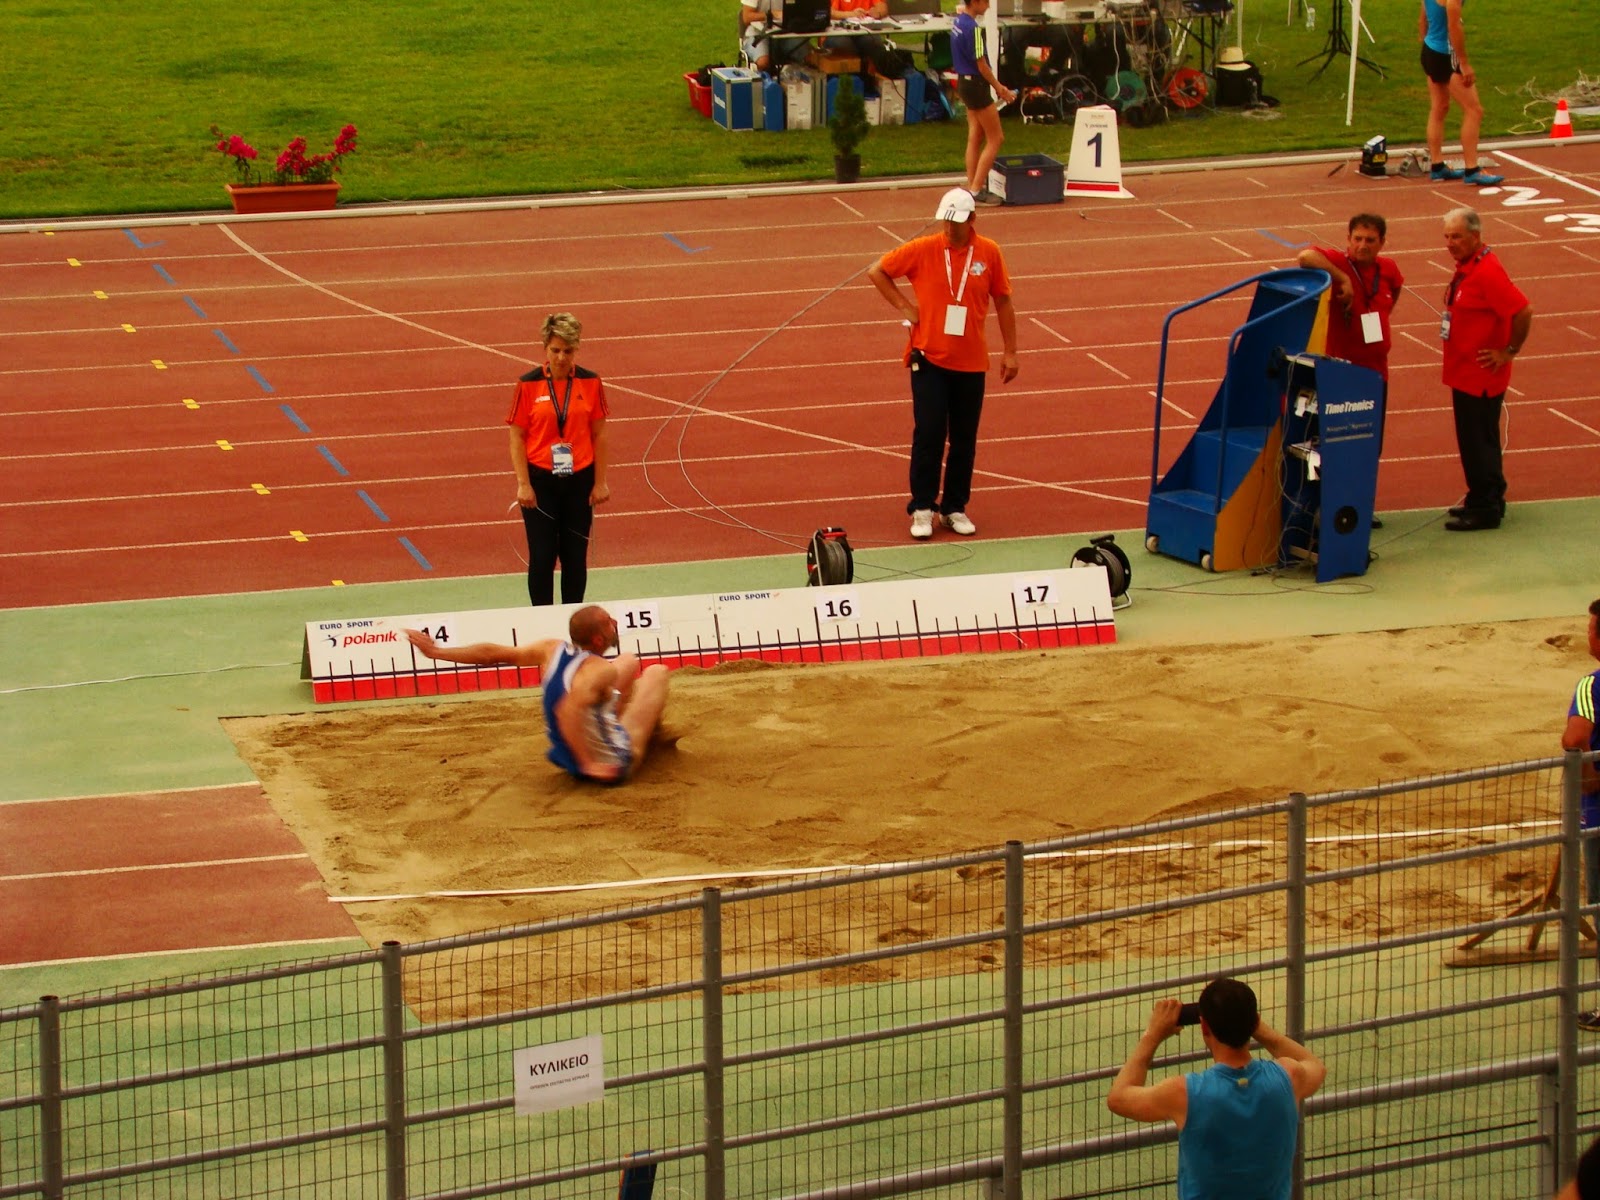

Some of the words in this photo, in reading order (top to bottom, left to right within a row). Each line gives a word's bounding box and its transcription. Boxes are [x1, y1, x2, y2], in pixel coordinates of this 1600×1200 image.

[1087, 132, 1102, 168] 1
[1478, 185, 1565, 207] 2
[1325, 399, 1375, 415] TimeTronics
[719, 594, 741, 602] EURO
[745, 592, 771, 600] SPORT
[1023, 585, 1050, 604] 17
[825, 599, 853, 618] 16
[319, 622, 342, 630] EURO
[346, 620, 374, 629] SPORT
[625, 610, 653, 629] 15
[343, 630, 398, 648] polanik
